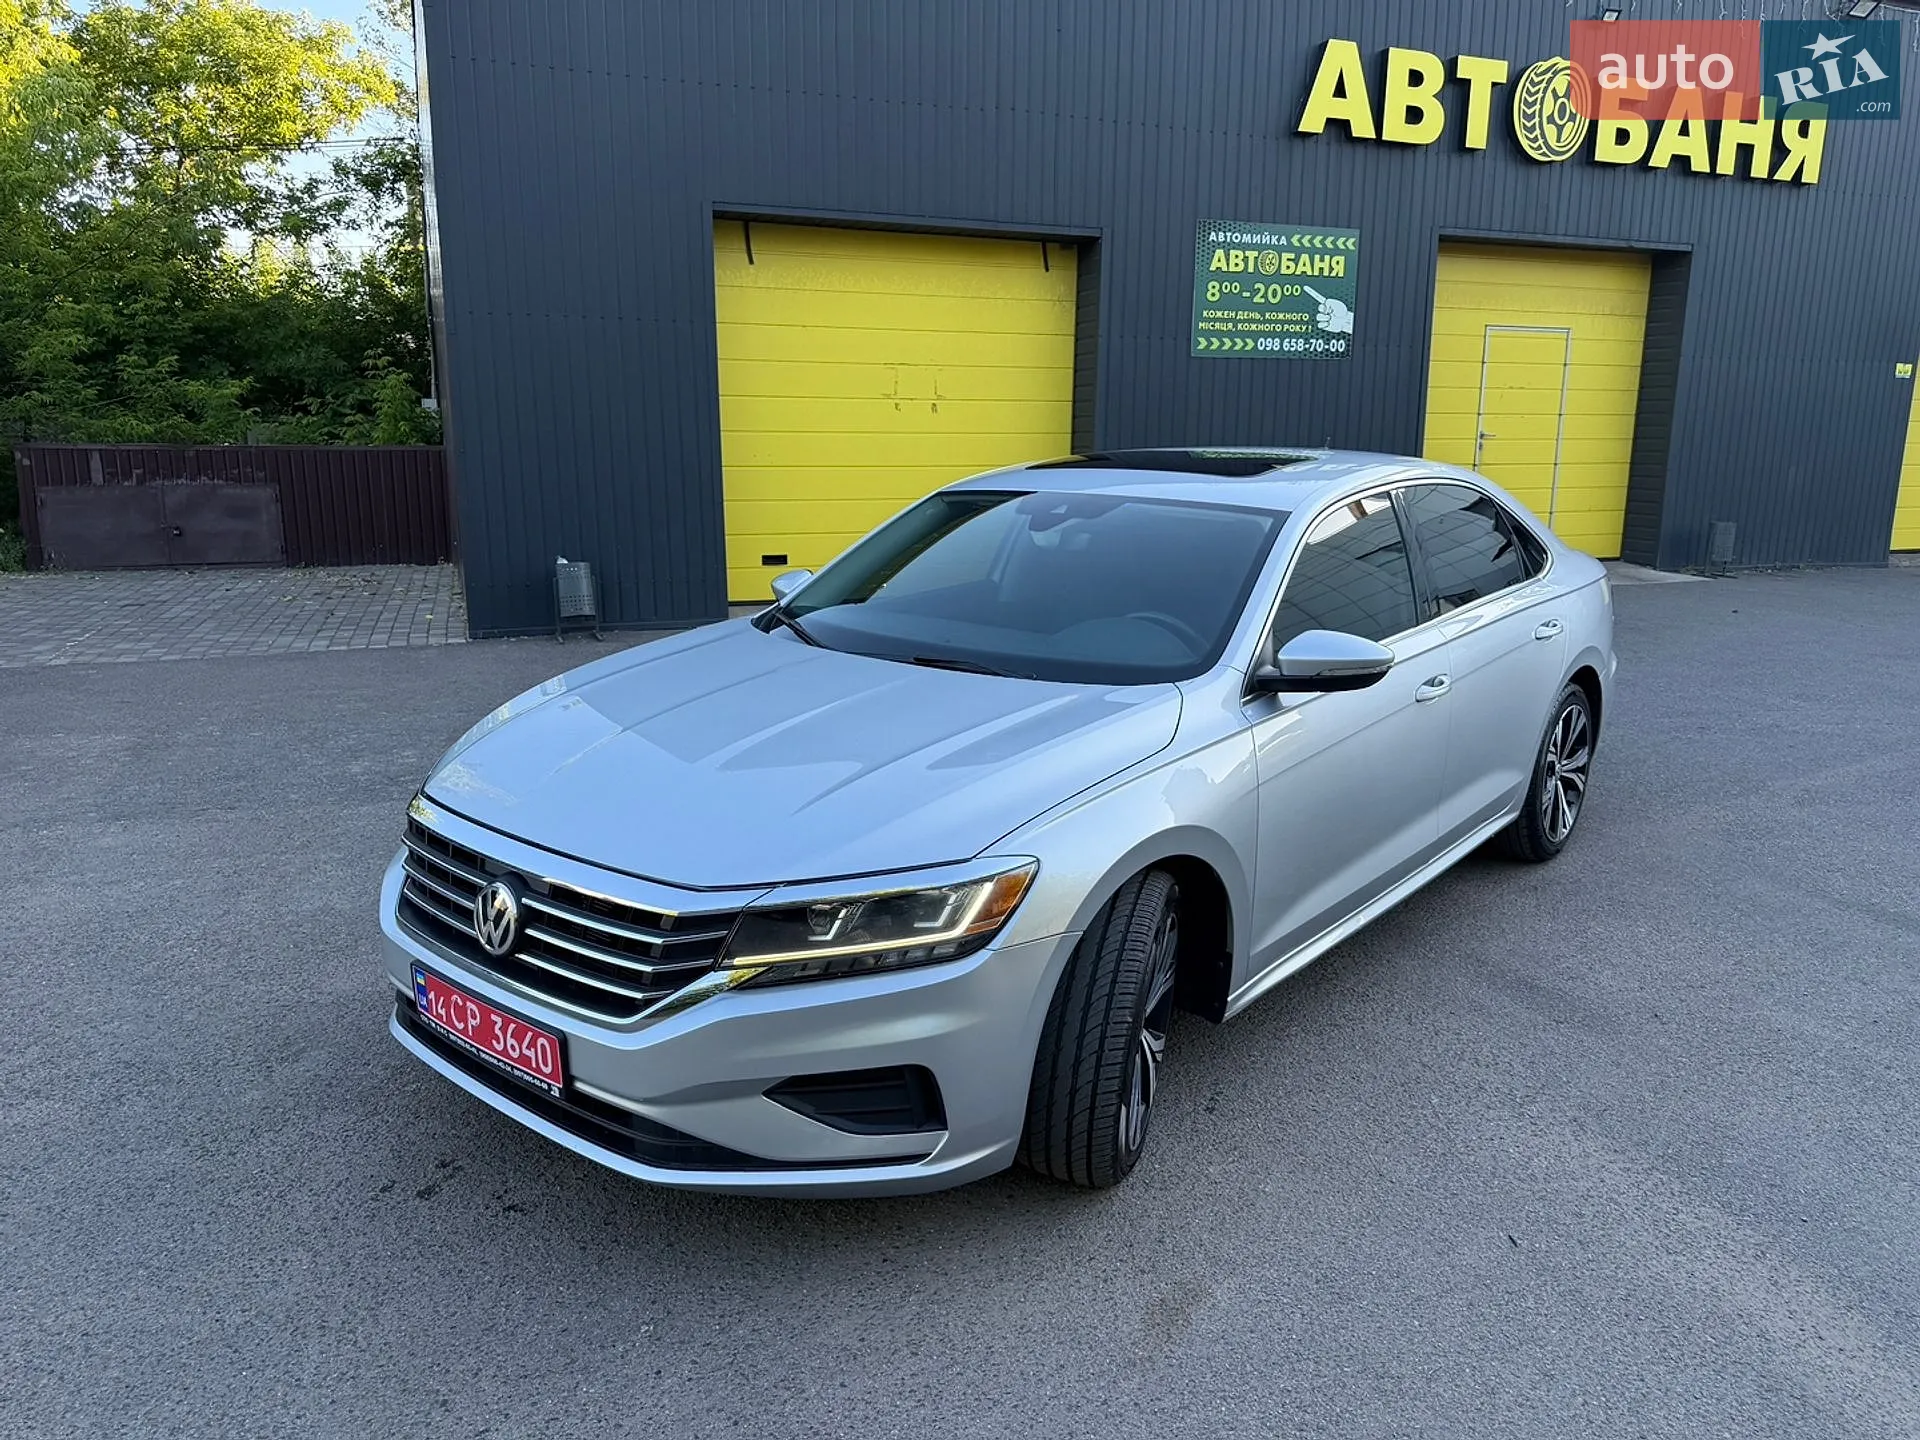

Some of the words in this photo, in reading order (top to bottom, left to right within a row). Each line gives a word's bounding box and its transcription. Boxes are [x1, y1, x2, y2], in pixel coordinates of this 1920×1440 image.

[1208, 231, 1288, 246] АВТОМИЙКА
[1209, 249, 1346, 278] АВТОБАНЯ
[1202, 309, 1236, 319] КОЖЕН
[1236, 310, 1264, 321] ДЕНЬ,
[1265, 311, 1310, 322] КОЖНОГО
[1198, 321, 1236, 332] МІСЯЦЯ,
[1237, 322, 1283, 332] КОЖНОГО
[1257, 337, 1281, 351] 098
[1282, 338, 1346, 352] 658-70-00
